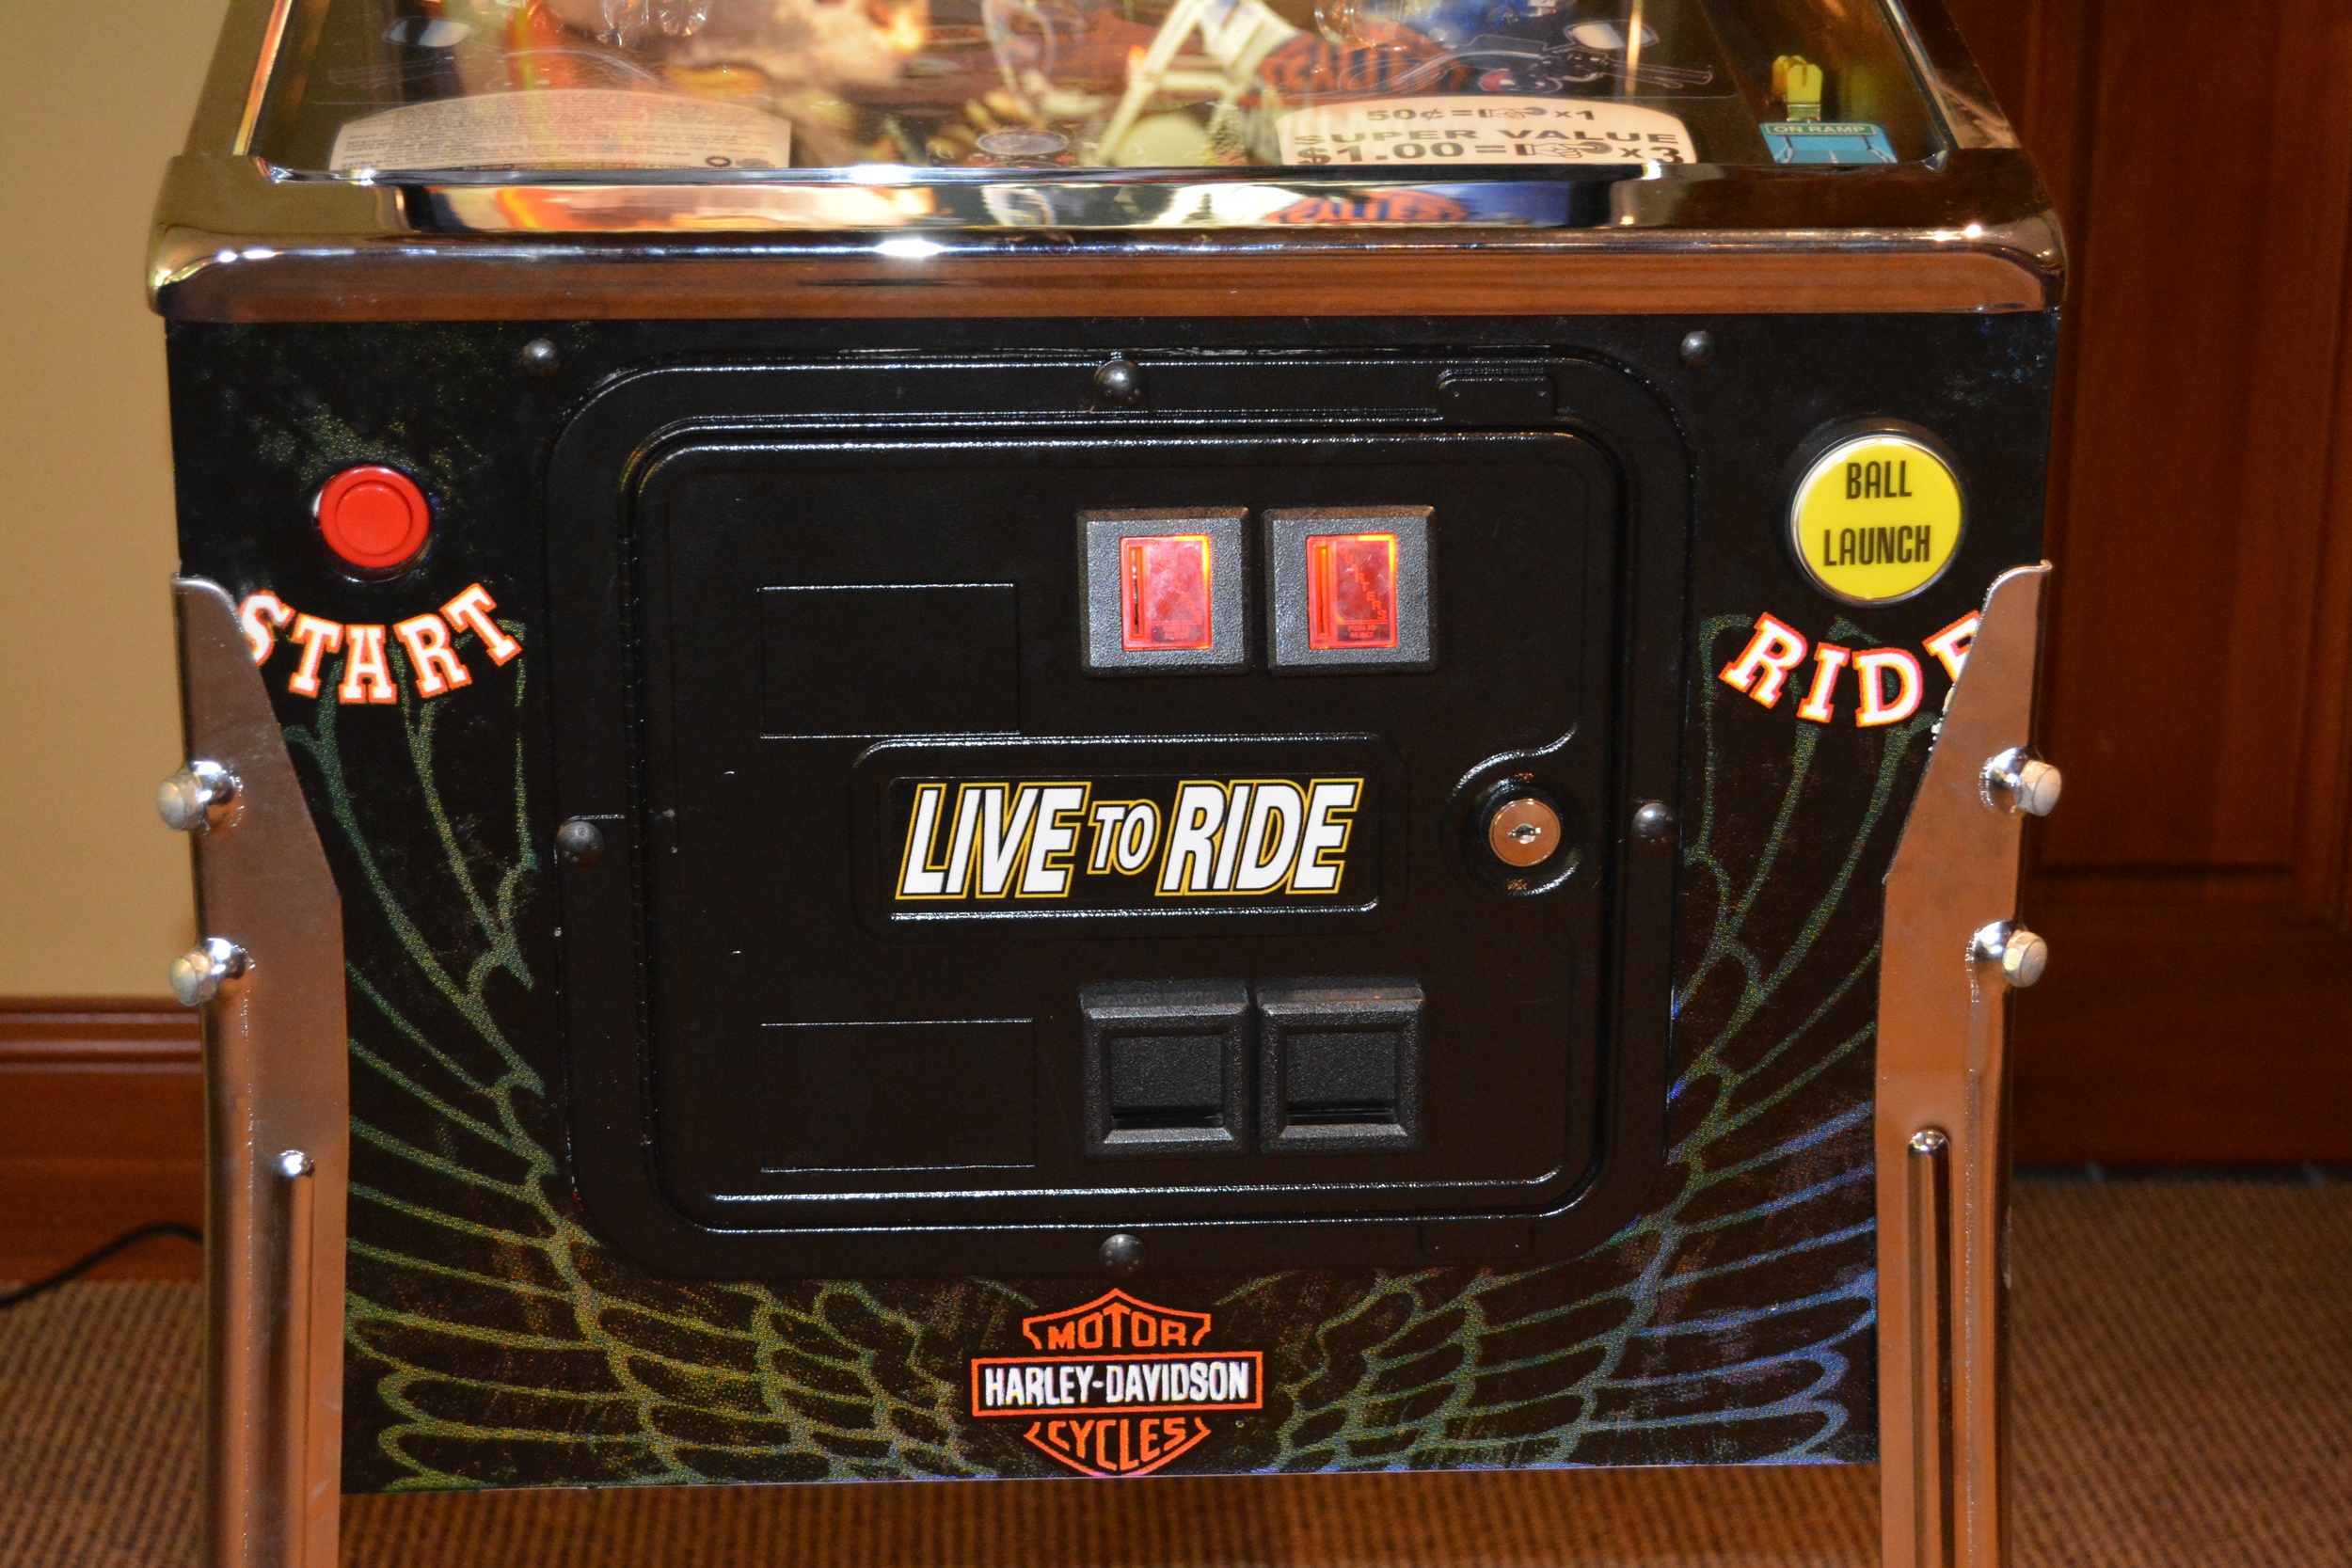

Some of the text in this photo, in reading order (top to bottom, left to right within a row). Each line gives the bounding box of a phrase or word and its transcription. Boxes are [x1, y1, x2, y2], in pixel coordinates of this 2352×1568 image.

[1294, 130, 1679, 145] SUPER VALUE
[1846, 460, 1913, 499] BALL
[1823, 525, 1931, 566] LAUNCH
[238, 582, 523, 705] START
[896, 778, 1365, 899] LIVE TO RIDE
[1047, 1302, 1186, 1350] MOTOR
[985, 1361, 1249, 1406] HARLEY-DAVIDSON
[1047, 1418, 1186, 1471] CYCLES
